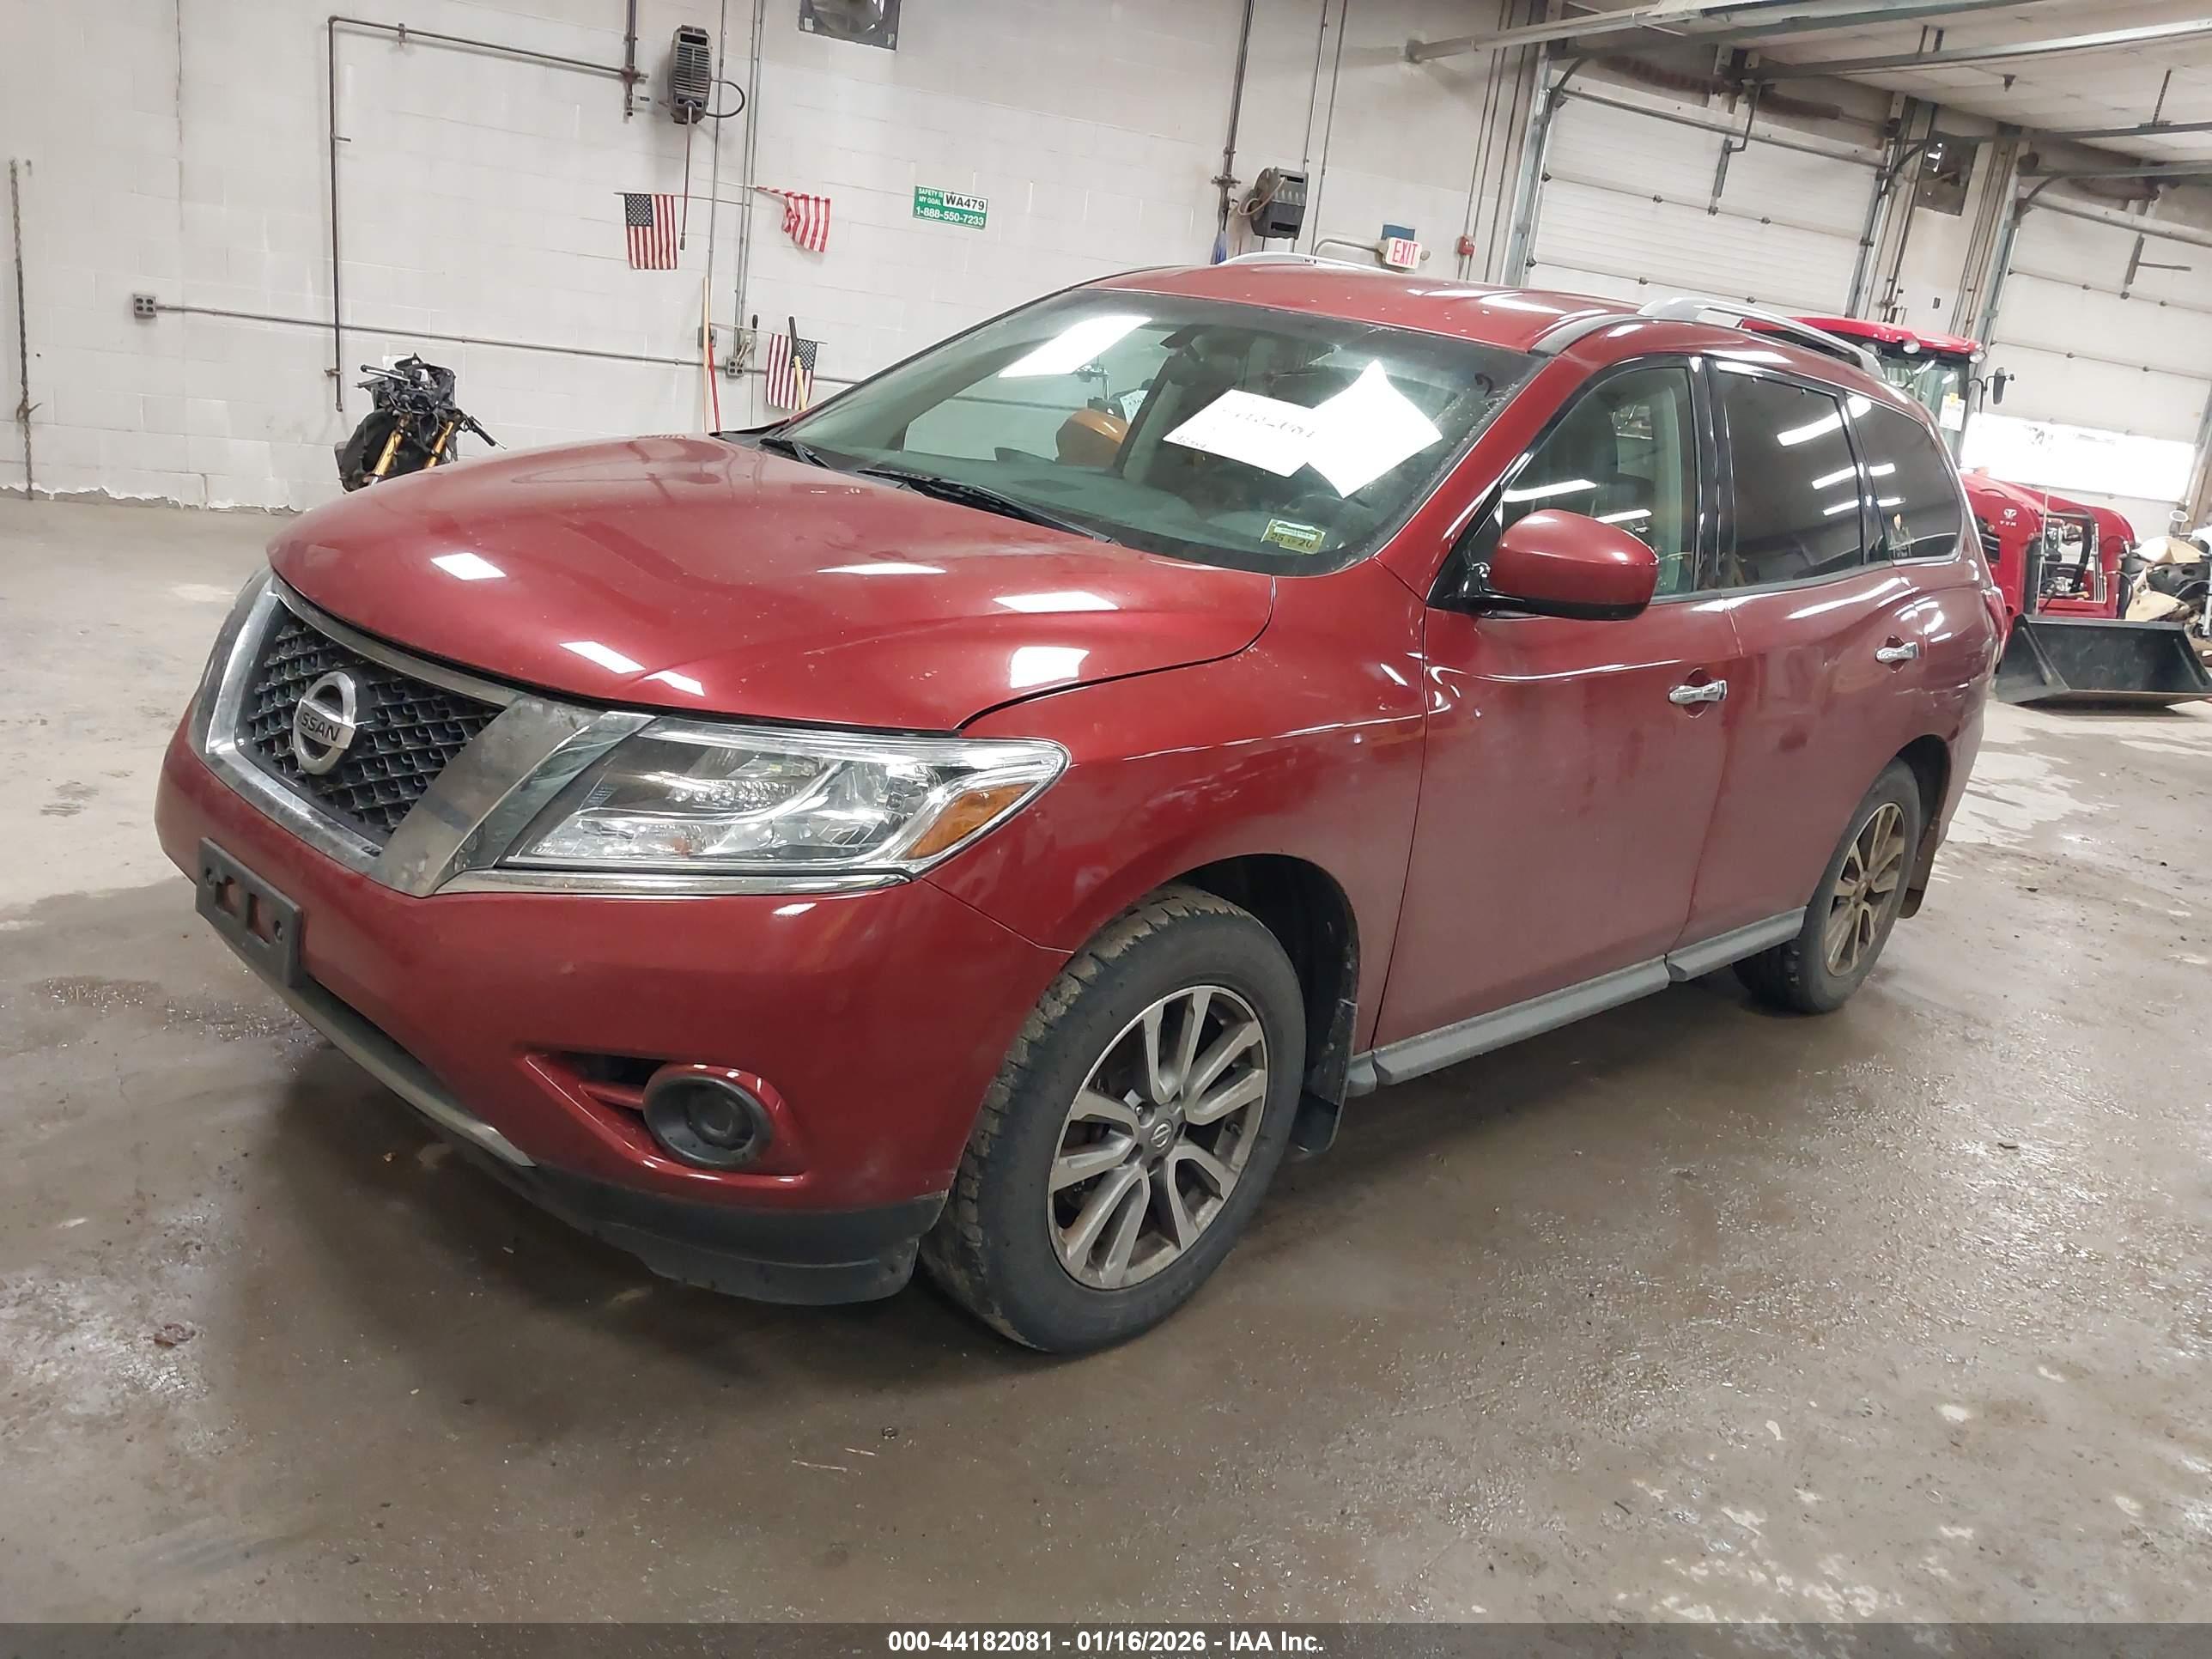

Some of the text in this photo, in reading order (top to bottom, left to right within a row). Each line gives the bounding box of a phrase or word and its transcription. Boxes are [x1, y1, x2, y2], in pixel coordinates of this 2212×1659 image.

[918, 188, 938, 197] SAFETY
[927, 198, 942, 206] GOAL
[945, 194, 985, 210] WA479
[915, 206, 984, 226] 1-888-550-7233
[1392, 240, 1418, 265] EXIT
